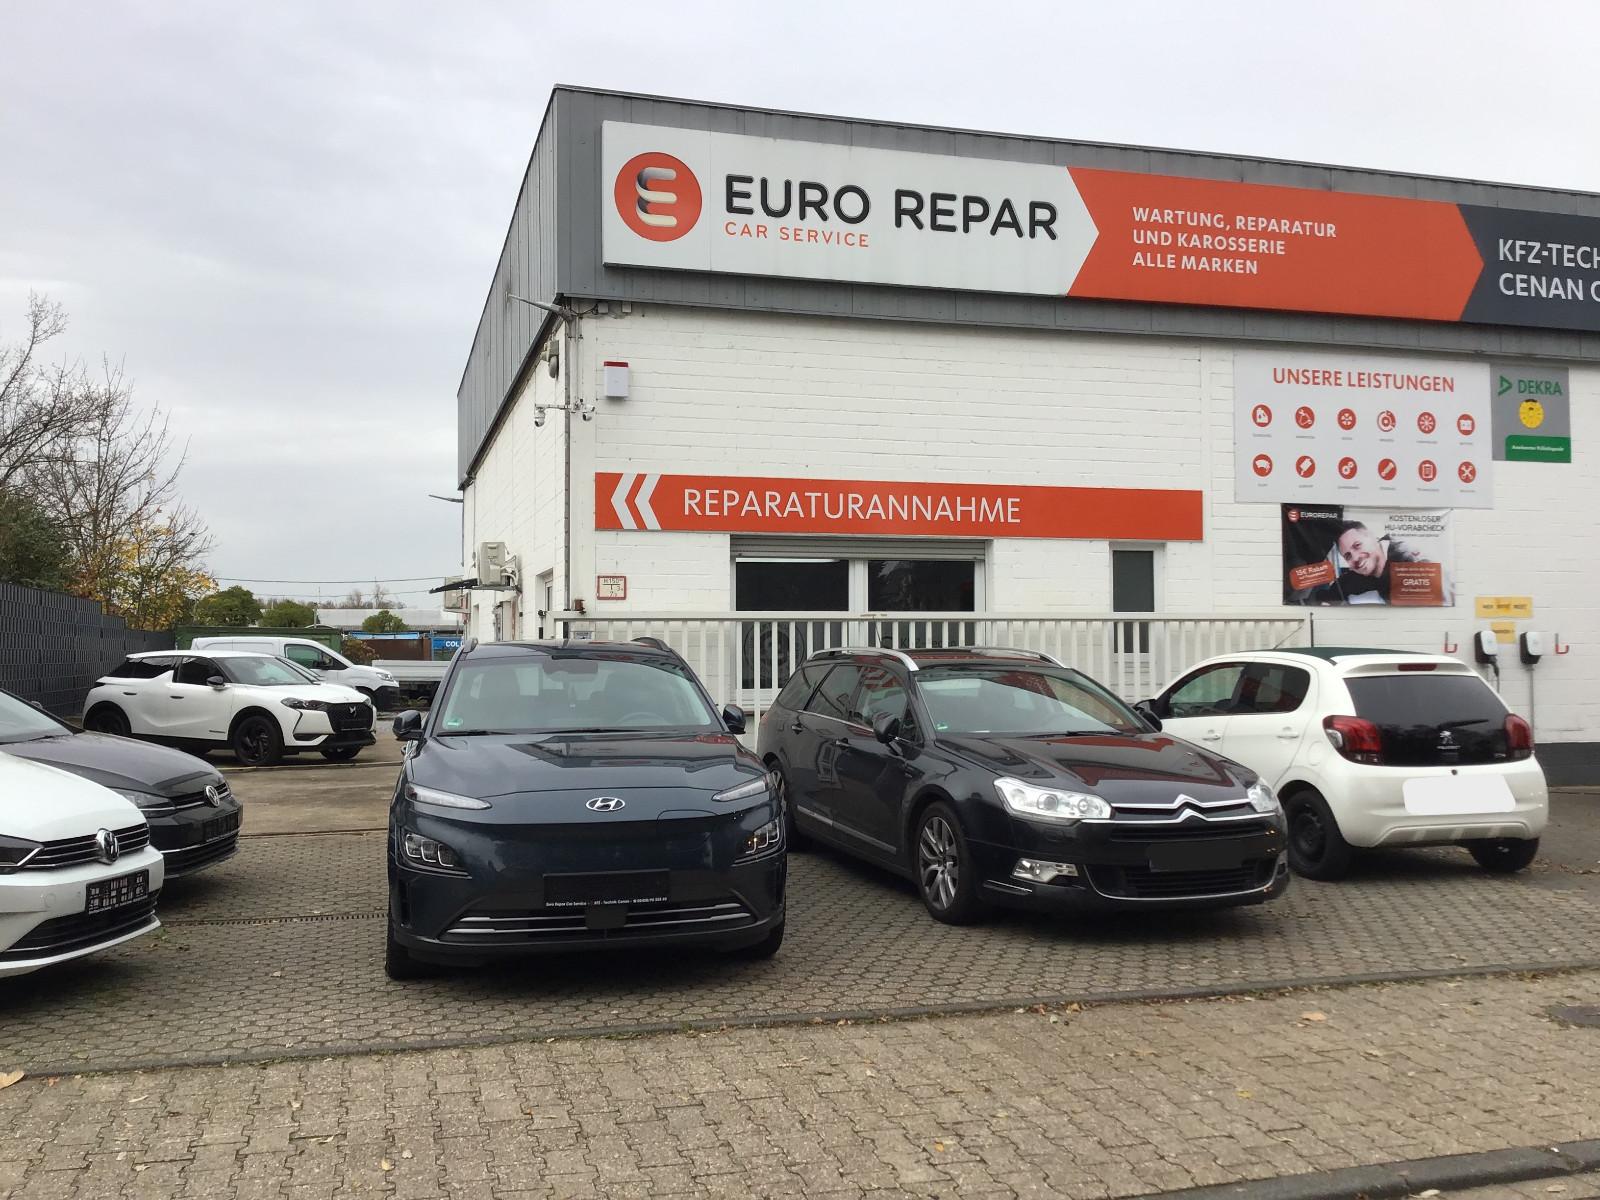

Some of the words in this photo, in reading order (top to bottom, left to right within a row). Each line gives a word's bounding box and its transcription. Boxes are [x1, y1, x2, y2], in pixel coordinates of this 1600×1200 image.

[725, 174, 871, 225] EURO
[894, 189, 1057, 241] REPAR
[724, 221, 768, 240] CAR
[779, 226, 870, 248] SERVICE
[1132, 206, 1231, 231] WARTUNG,
[1235, 215, 1338, 238] REPARATUR
[1132, 229, 1173, 246] UND
[1177, 233, 1286, 255] KAROSSERIE
[1132, 251, 1176, 268] ALLE
[1181, 255, 1259, 275] MARKEN
[1498, 272, 1584, 301] CENAN
[1272, 367, 1342, 387] UNSERE
[1346, 371, 1455, 393] LEISTUNGEN
[1517, 379, 1563, 396] DEKRA
[684, 487, 1022, 524] REPARATURANNAHME
[1389, 515, 1441, 523] KOSTENLOSER
[1402, 578, 1431, 587] GRATIS
